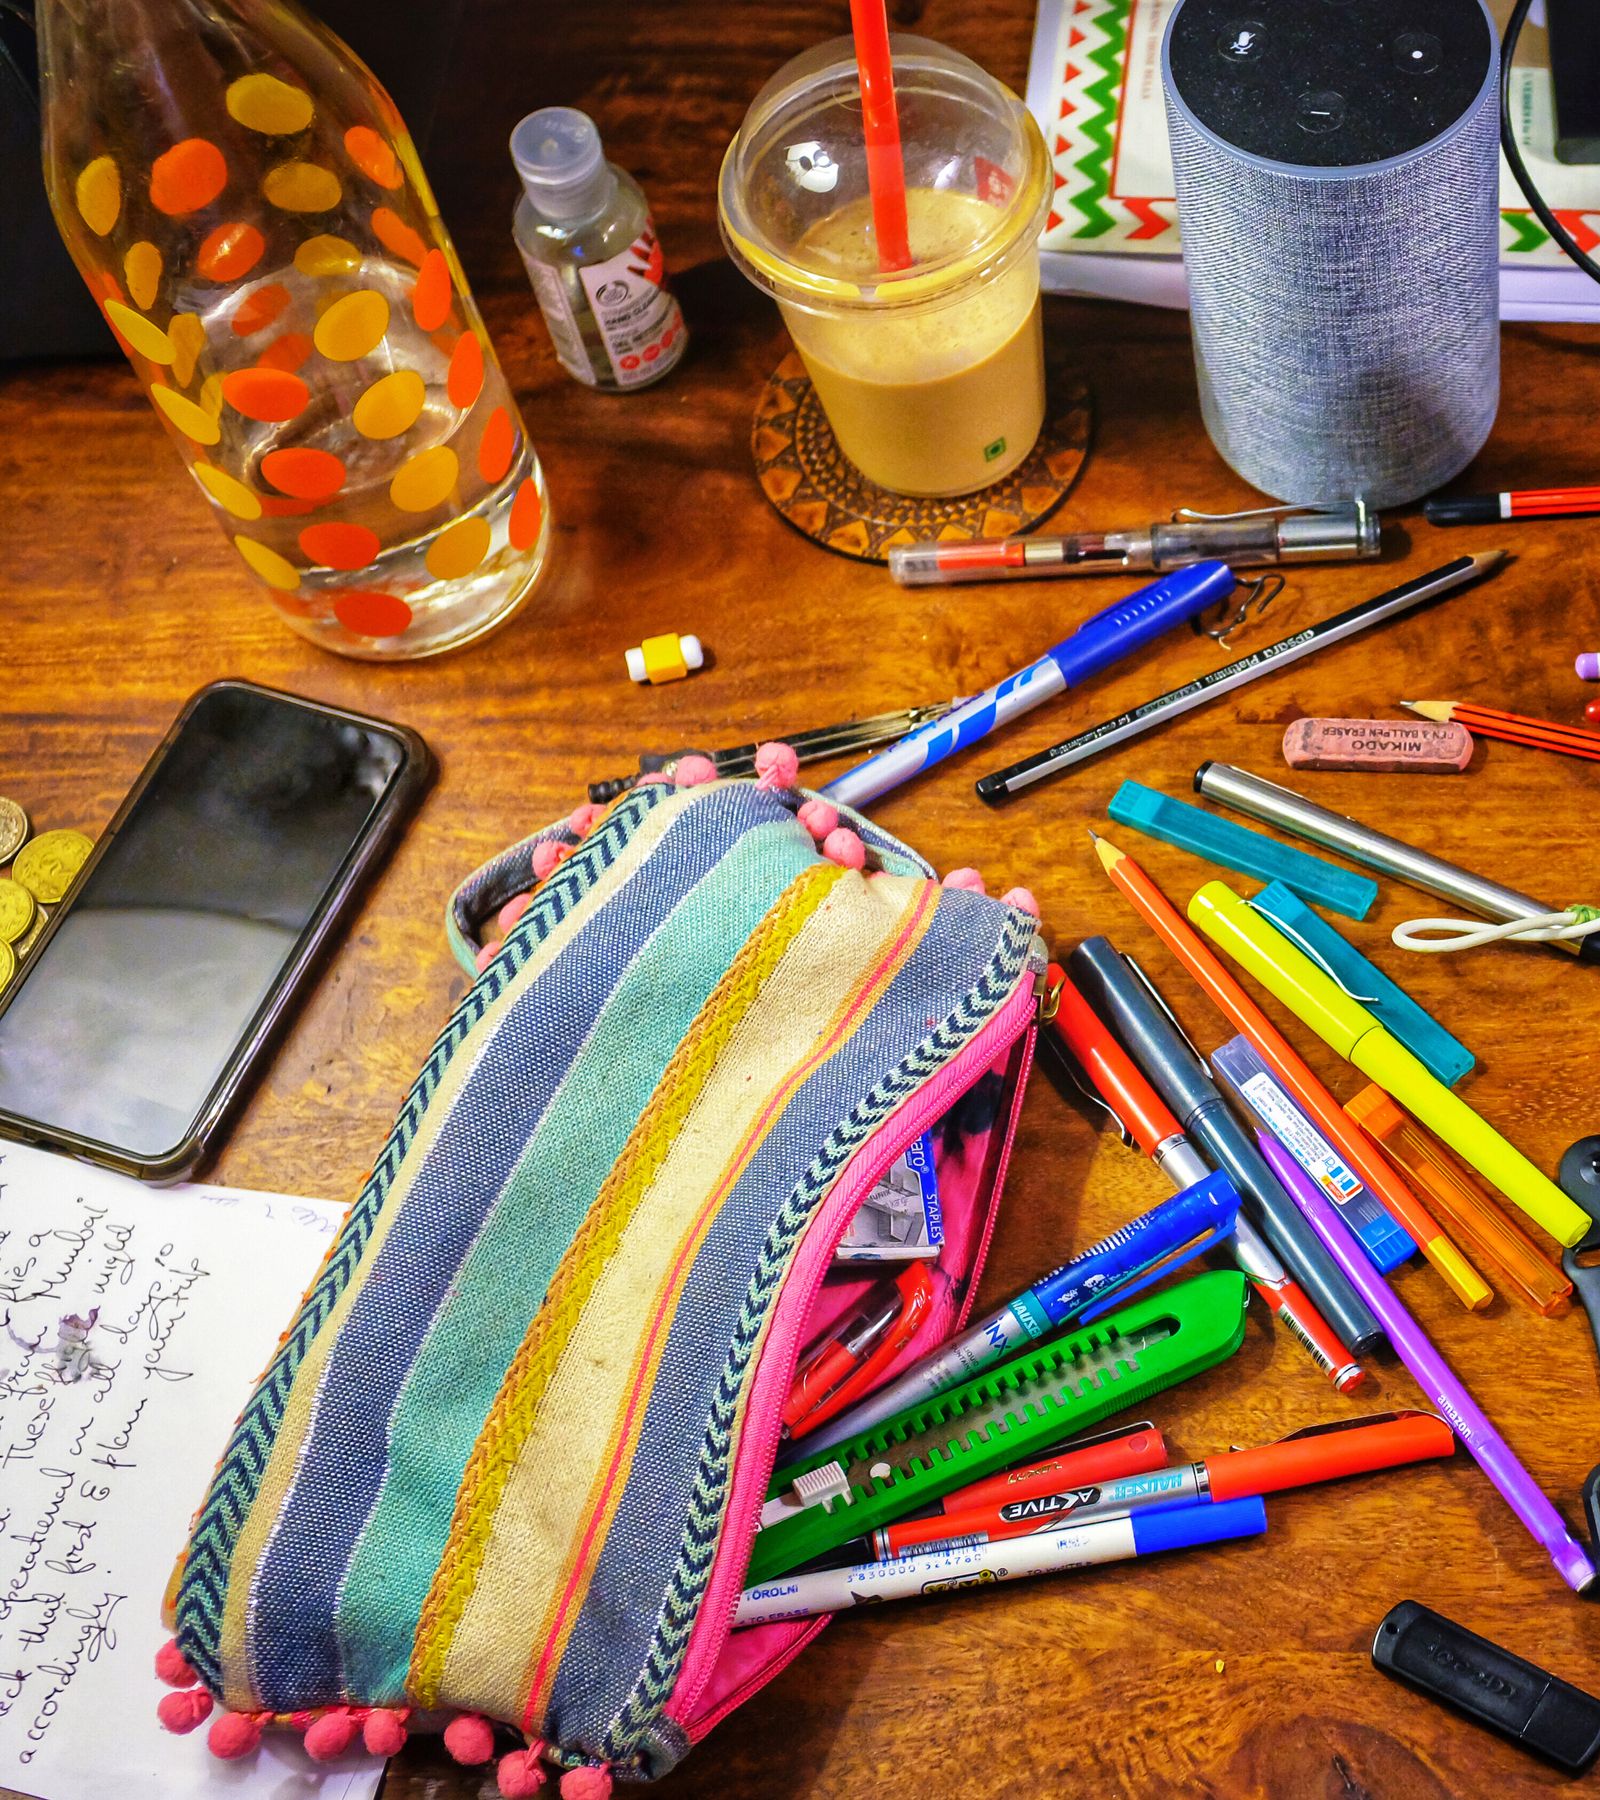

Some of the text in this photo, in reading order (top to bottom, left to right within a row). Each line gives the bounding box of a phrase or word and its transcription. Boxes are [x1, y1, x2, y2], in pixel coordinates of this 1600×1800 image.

[1264, 629, 1315, 659] apsara
[1322, 726, 1365, 737] ERASER
[1352, 740, 1422, 751] MIKADO
[1369, 728, 1418, 738] BALLPEN
[926, 1194, 942, 1239] STAPLES
[88, 1359, 122, 1403] all
[1436, 1394, 1474, 1439] amazon
[1009, 1488, 1095, 1518] ACTIVE
[18, 1591, 66, 1652] that
